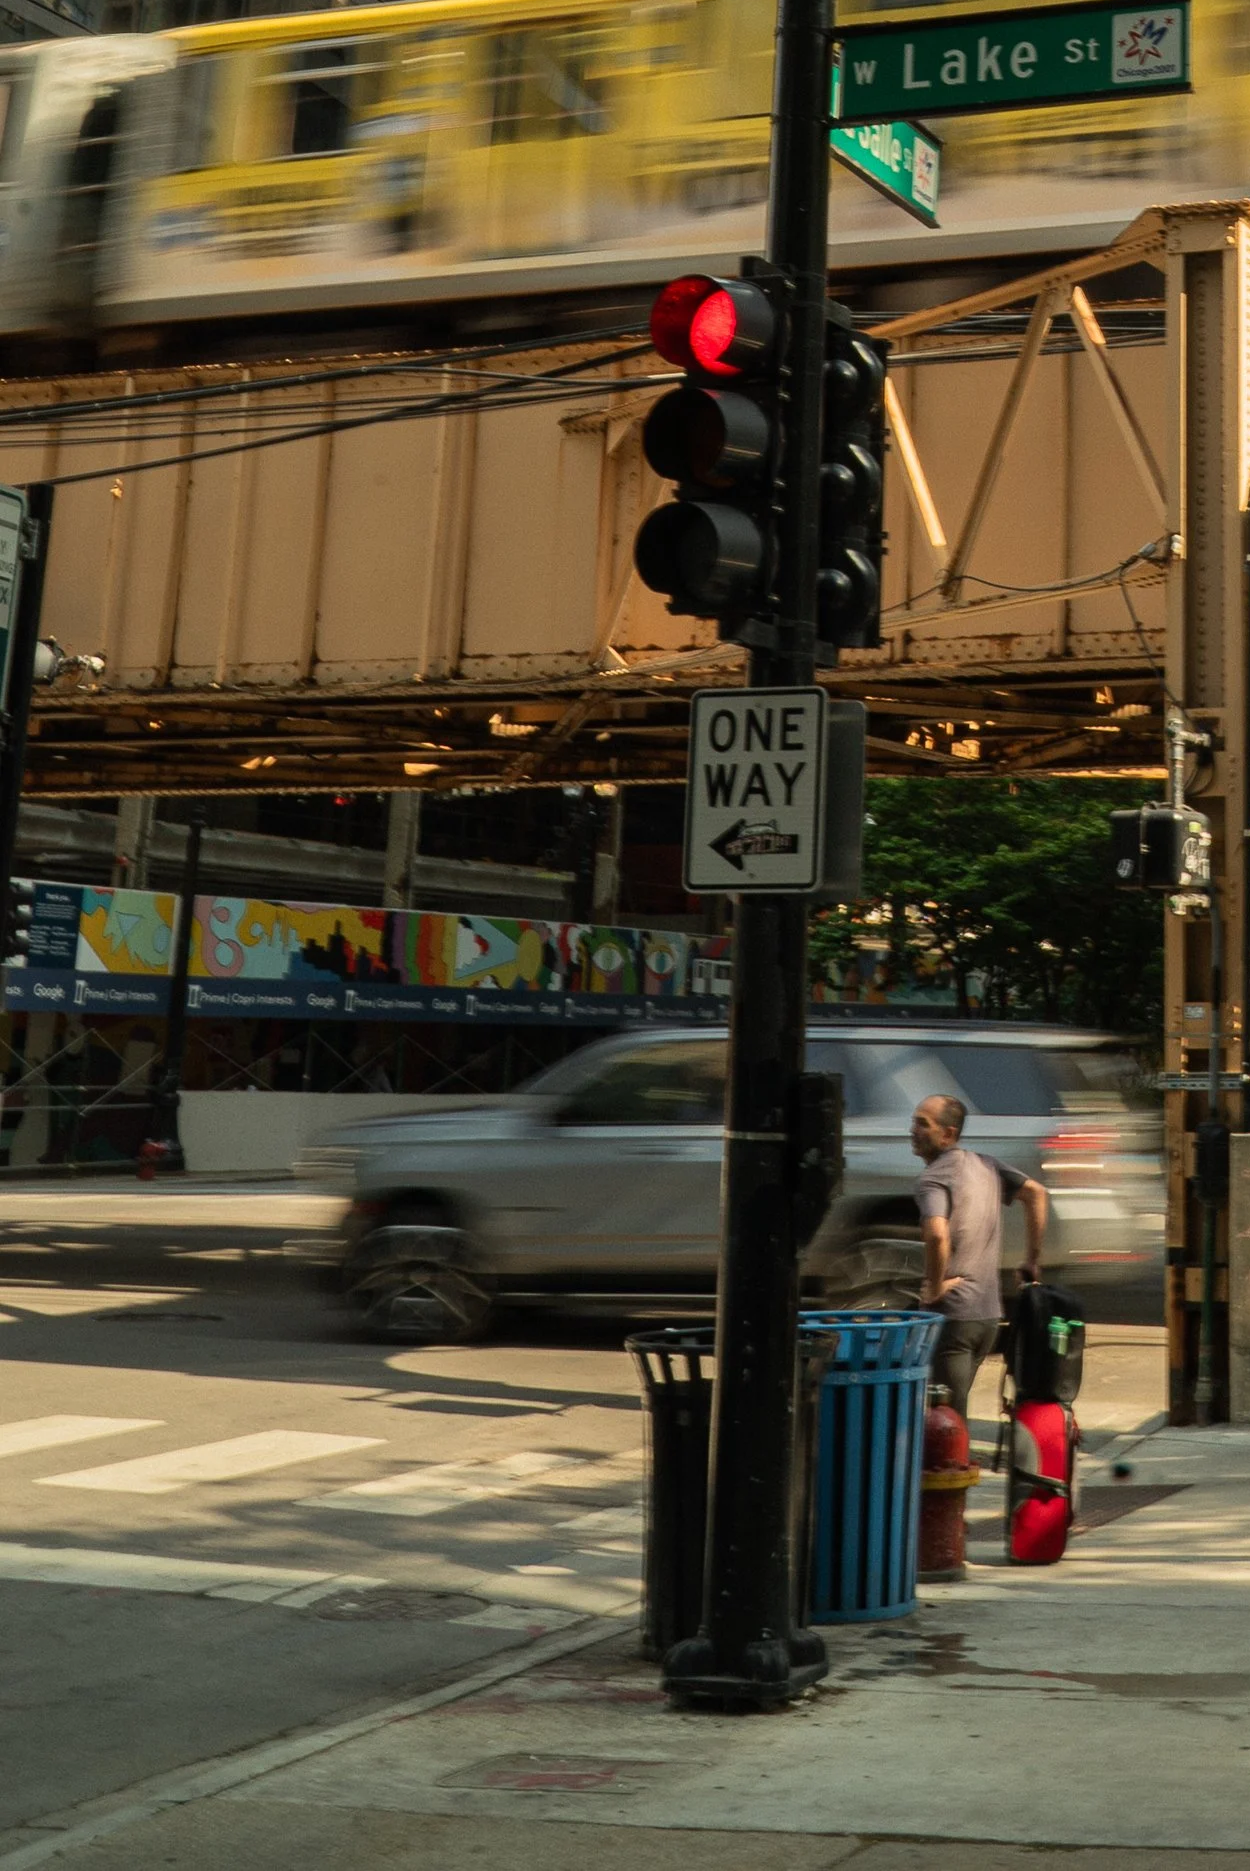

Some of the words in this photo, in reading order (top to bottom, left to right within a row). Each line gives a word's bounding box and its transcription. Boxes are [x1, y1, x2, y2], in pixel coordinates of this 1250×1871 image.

[854, 60, 877, 85] W
[904, 37, 1038, 89] Lake
[1064, 37, 1100, 64] St
[709, 707, 806, 753] ONE
[703, 761, 807, 808] WAY
[33, 983, 65, 1001] Google
